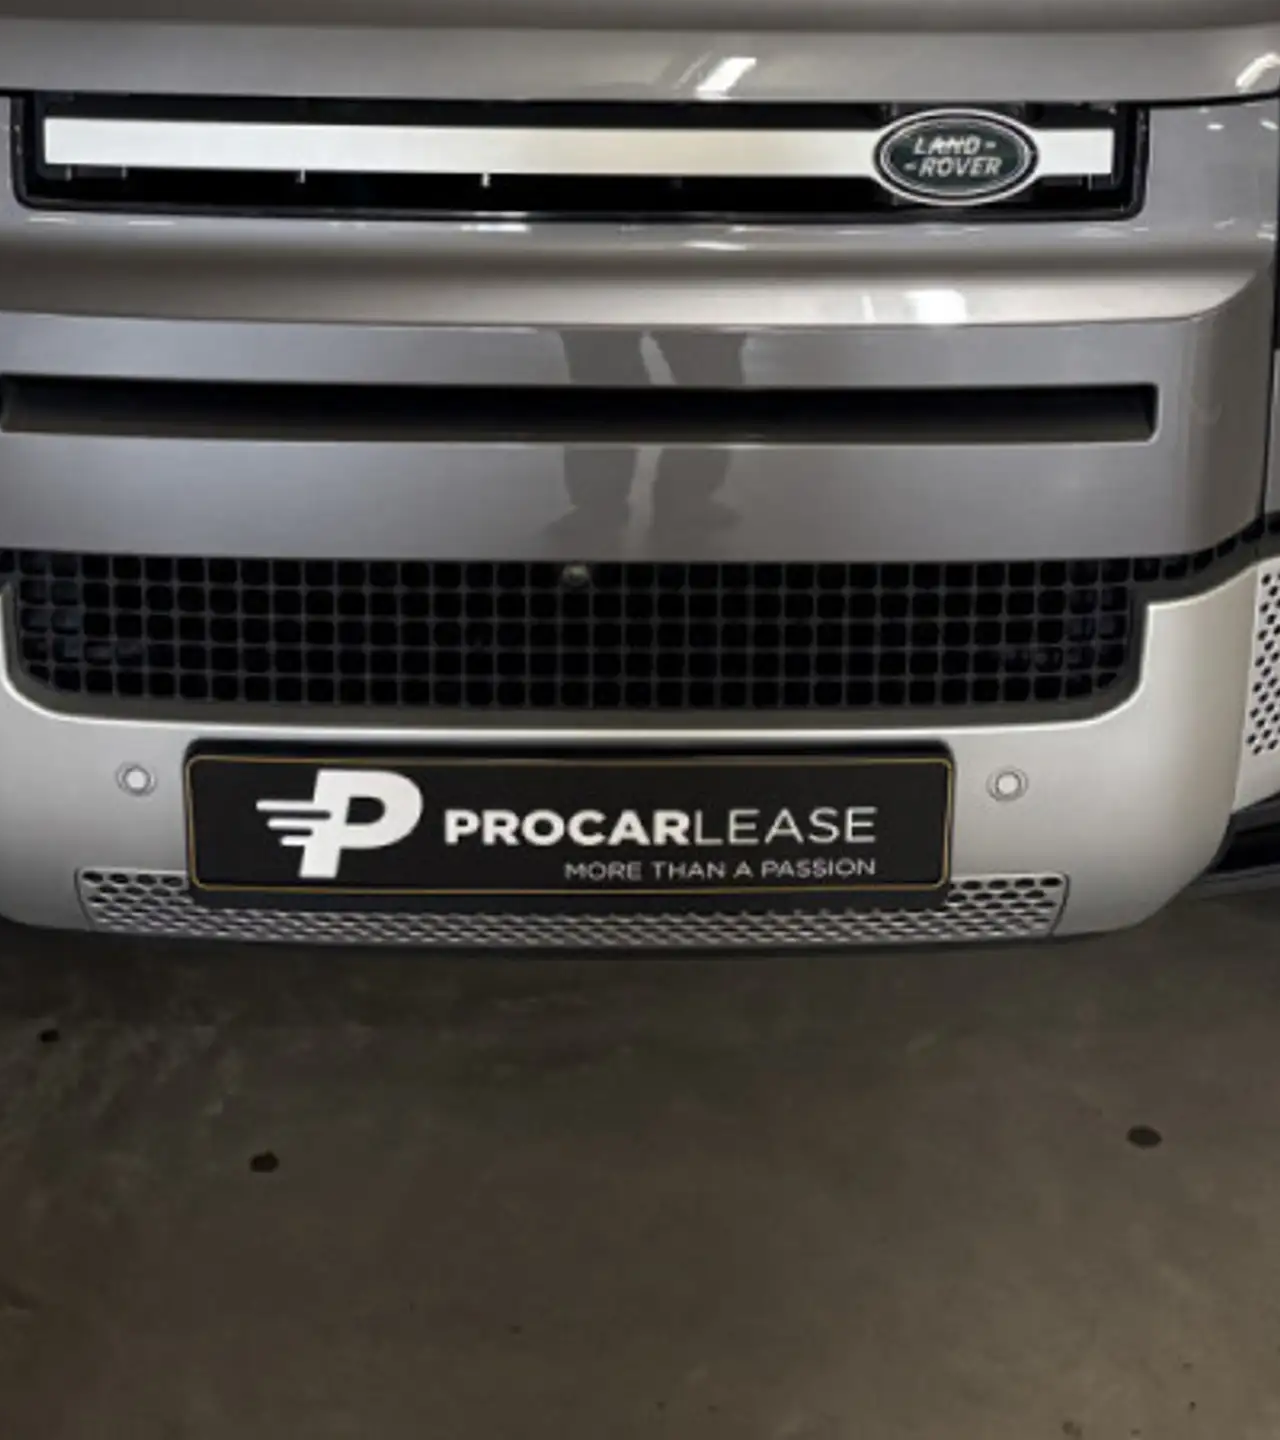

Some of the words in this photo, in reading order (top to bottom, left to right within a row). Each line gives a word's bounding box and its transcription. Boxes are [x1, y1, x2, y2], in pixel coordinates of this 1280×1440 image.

[443, 806, 878, 846] PROCARLEASE
[563, 861, 642, 882] MORE
[653, 861, 728, 881] THAN
[734, 860, 755, 880] A
[761, 858, 878, 880] PASSION
